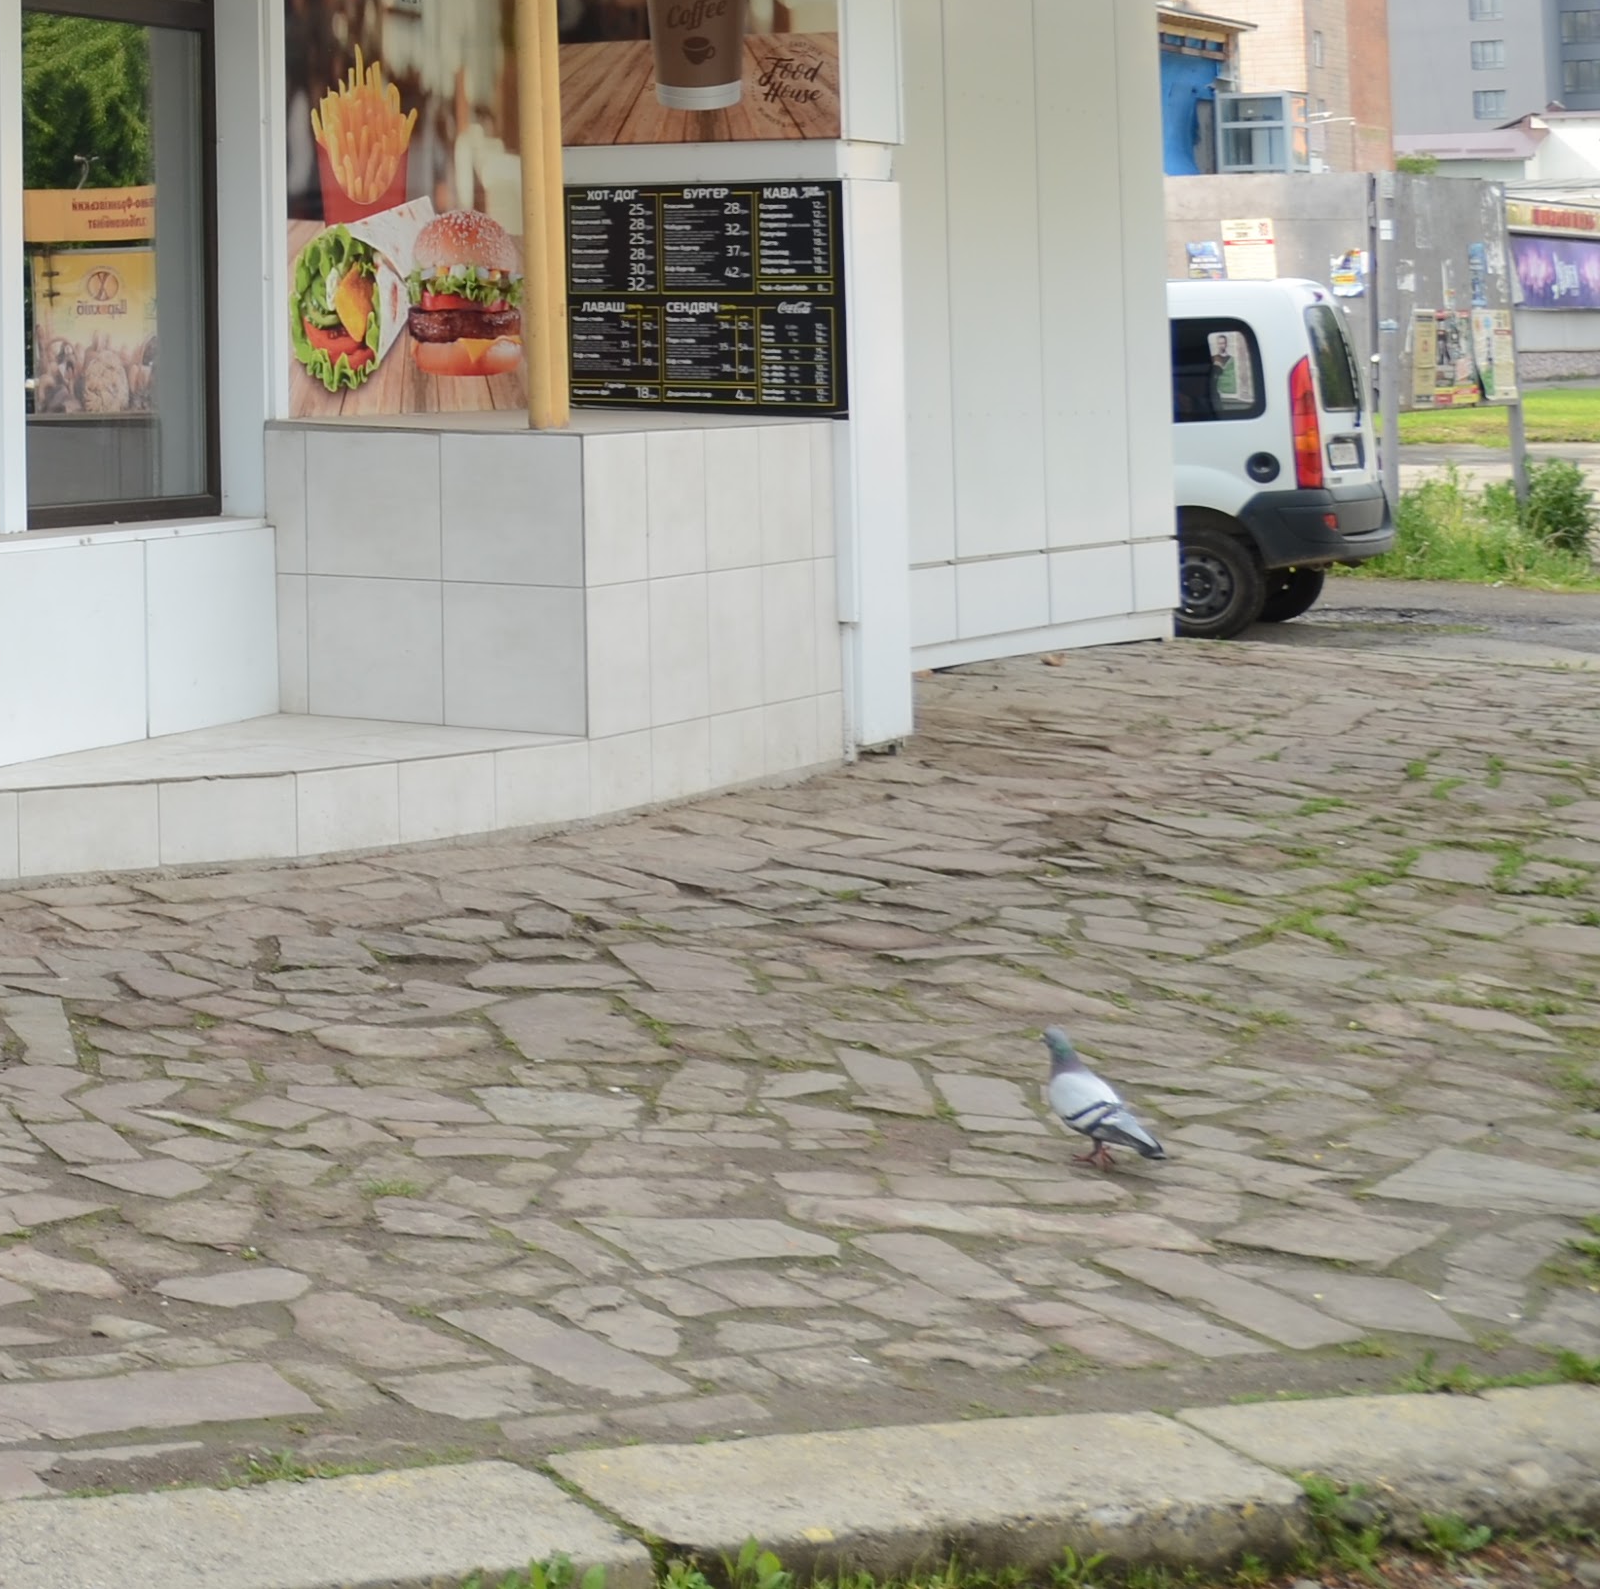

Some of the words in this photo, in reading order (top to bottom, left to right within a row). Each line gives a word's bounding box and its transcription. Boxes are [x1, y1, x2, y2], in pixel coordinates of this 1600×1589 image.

[758, 56, 824, 87] Food
[762, 80, 824, 104] House
[586, 189, 639, 202] ХОТ-ДОГ
[682, 188, 729, 199] БУРГЕР
[762, 187, 799, 199] КАВА
[581, 301, 625, 313] ЛАВАШ
[666, 301, 718, 315] СЕНДВІЧ
